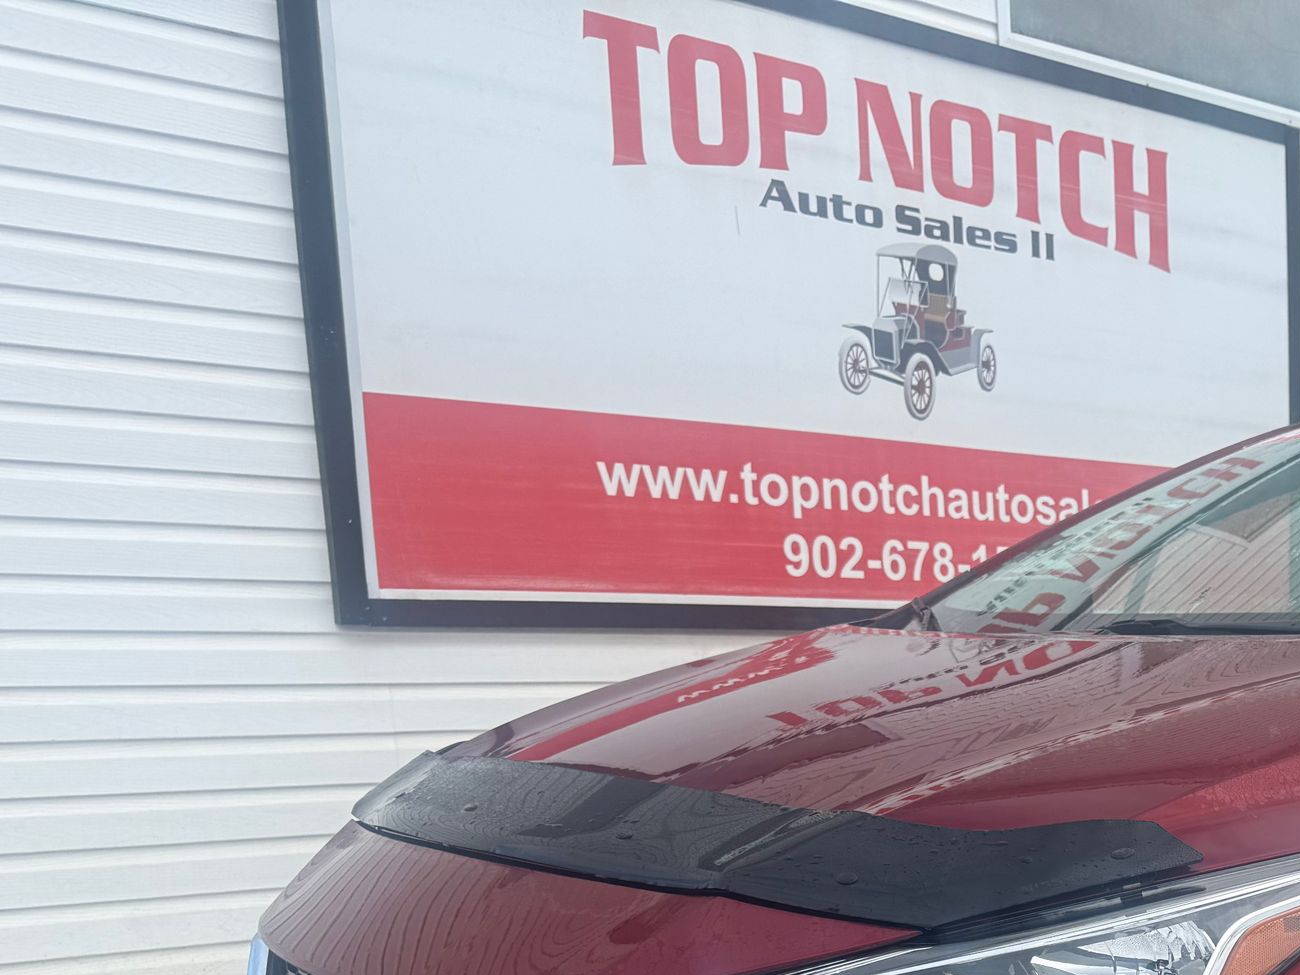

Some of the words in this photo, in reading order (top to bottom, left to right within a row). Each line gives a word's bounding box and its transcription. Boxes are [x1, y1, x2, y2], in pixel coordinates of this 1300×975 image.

[582, 10, 828, 171] TOP
[854, 77, 1172, 273] NOTCH
[759, 178, 884, 229] Auto
[895, 204, 1019, 254] Sales
[1031, 230, 1055, 261] II
[596, 461, 1102, 528] www.topnotchautosal
[783, 533, 1009, 583] 902-678-1
